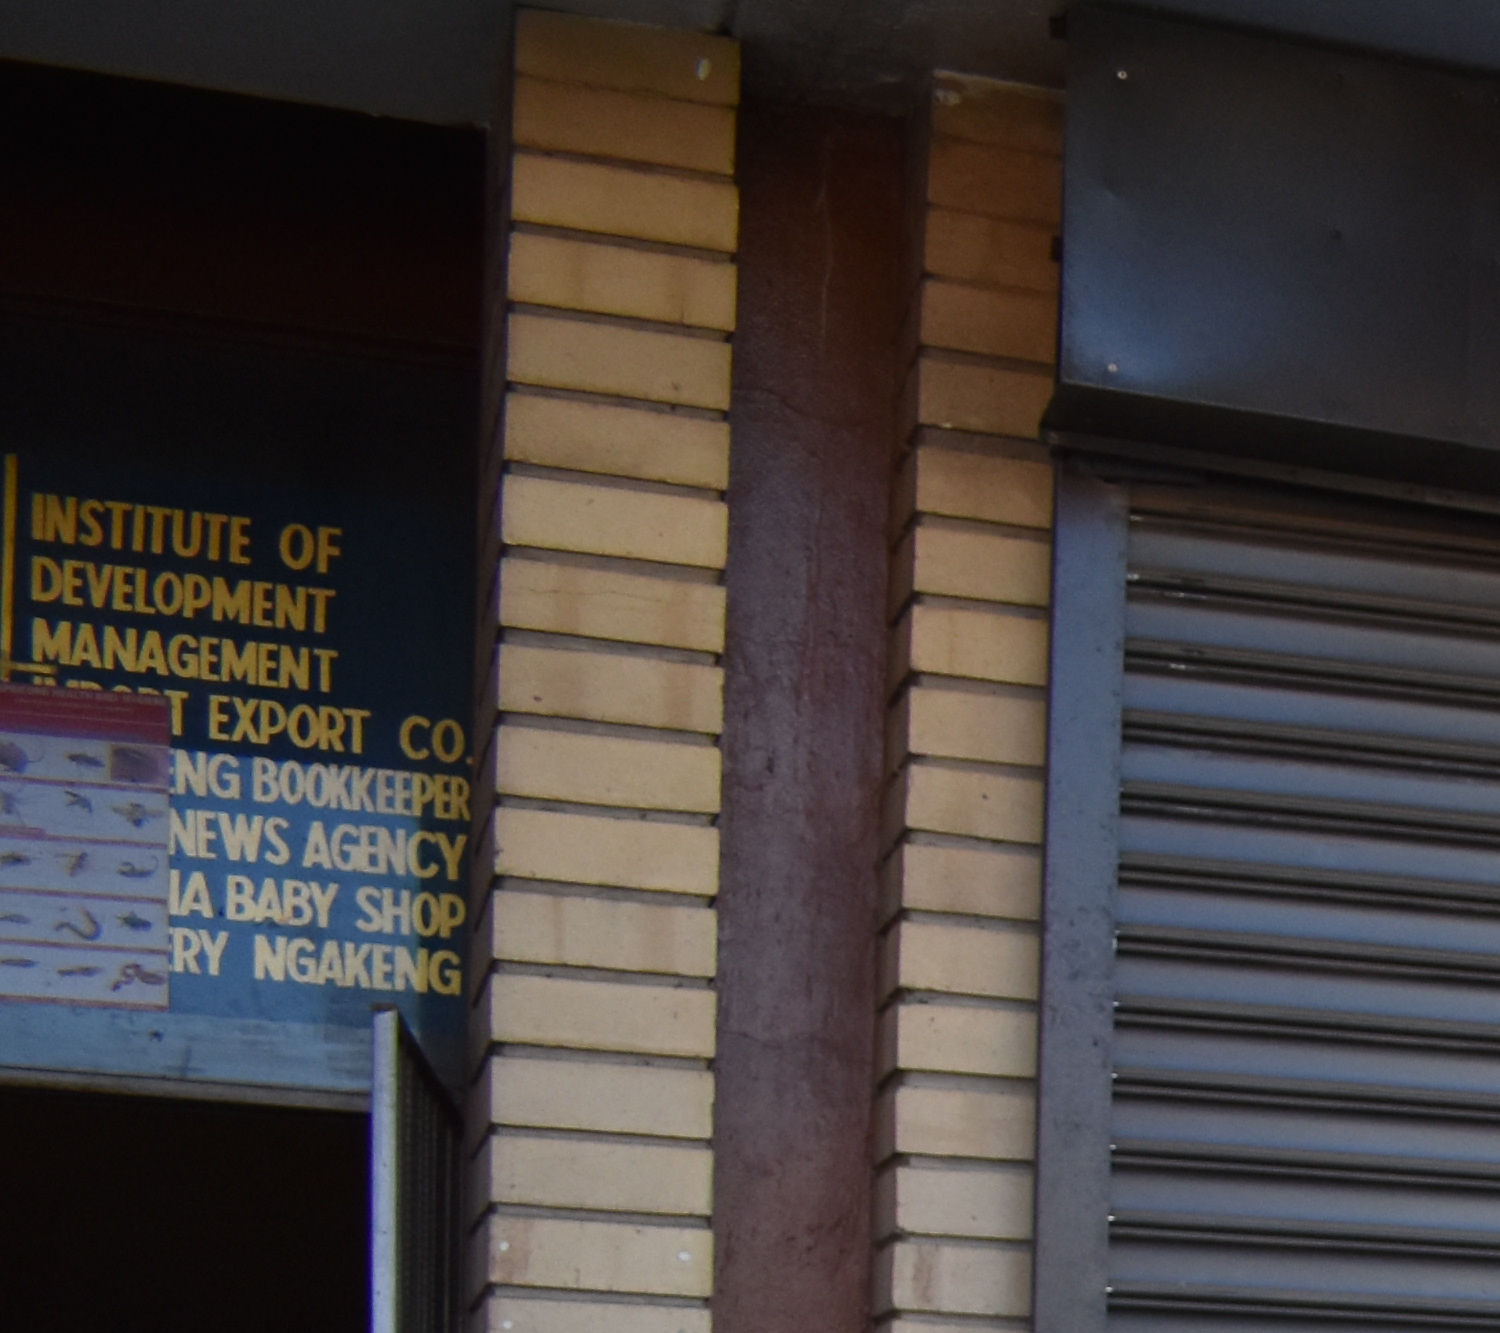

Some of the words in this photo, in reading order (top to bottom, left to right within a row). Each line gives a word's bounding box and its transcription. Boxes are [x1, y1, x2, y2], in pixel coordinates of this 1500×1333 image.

[31, 493, 251, 565] INSTITUTE
[279, 523, 343, 574] OF
[31, 556, 336, 633] DEVELOPMENT
[32, 617, 338, 692] MANAGEMENT
[209, 695, 371, 754] EXPORT
[400, 716, 475, 765] CO.
[253, 760, 471, 821] BOOKKEEPER
[169, 808, 290, 867] NEWS
[302, 821, 468, 881] AGENCY
[226, 875, 338, 929] BABY
[356, 886, 466, 938] SHOP
[255, 934, 462, 997] NGAKENG
